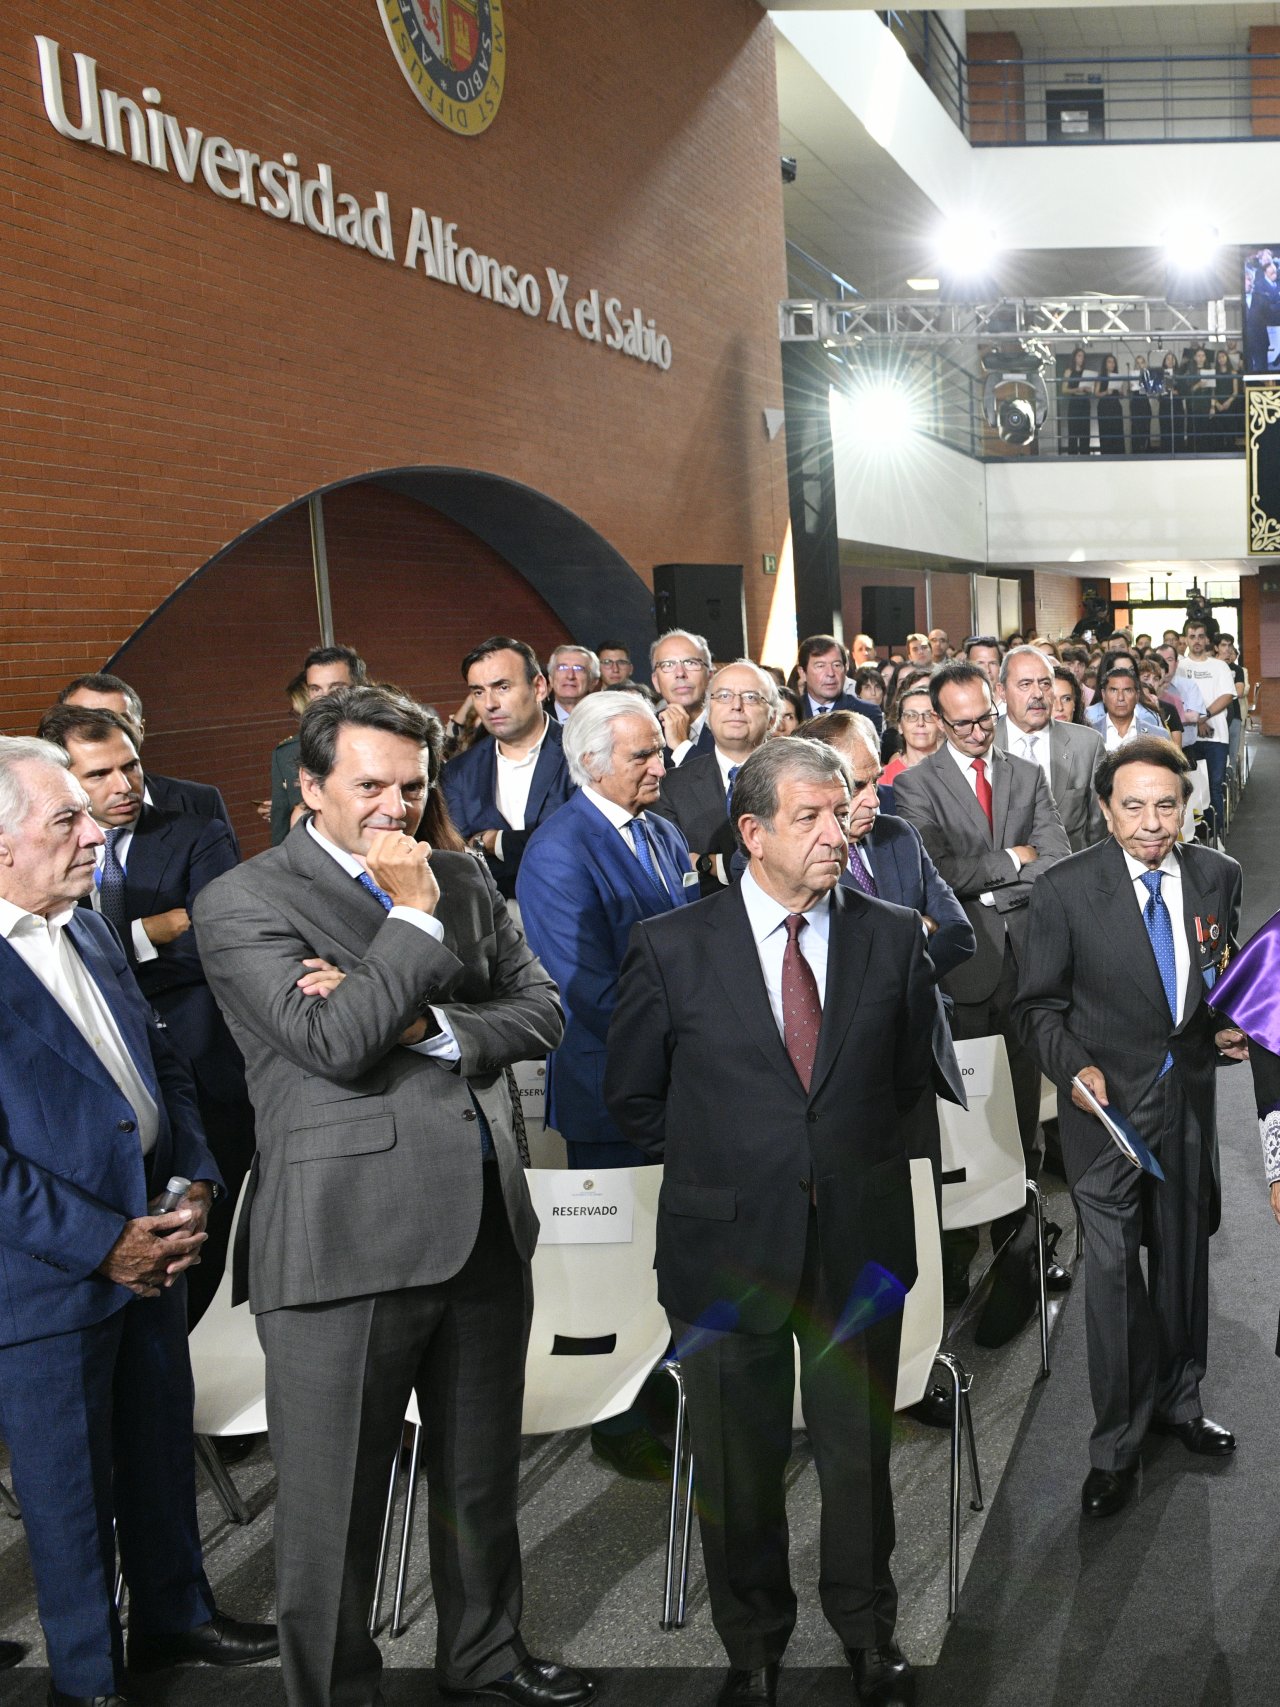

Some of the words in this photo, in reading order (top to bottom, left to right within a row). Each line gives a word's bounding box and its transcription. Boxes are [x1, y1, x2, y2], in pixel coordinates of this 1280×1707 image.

[34, 34, 395, 261] Universidad
[403, 207, 541, 317] Alfonso
[546, 267, 573, 330] X
[575, 289, 601, 342] el
[605, 297, 672, 370] Sabio
[519, 1088, 546, 1097] ESERV
[552, 1205, 618, 1217] RESERVADO
